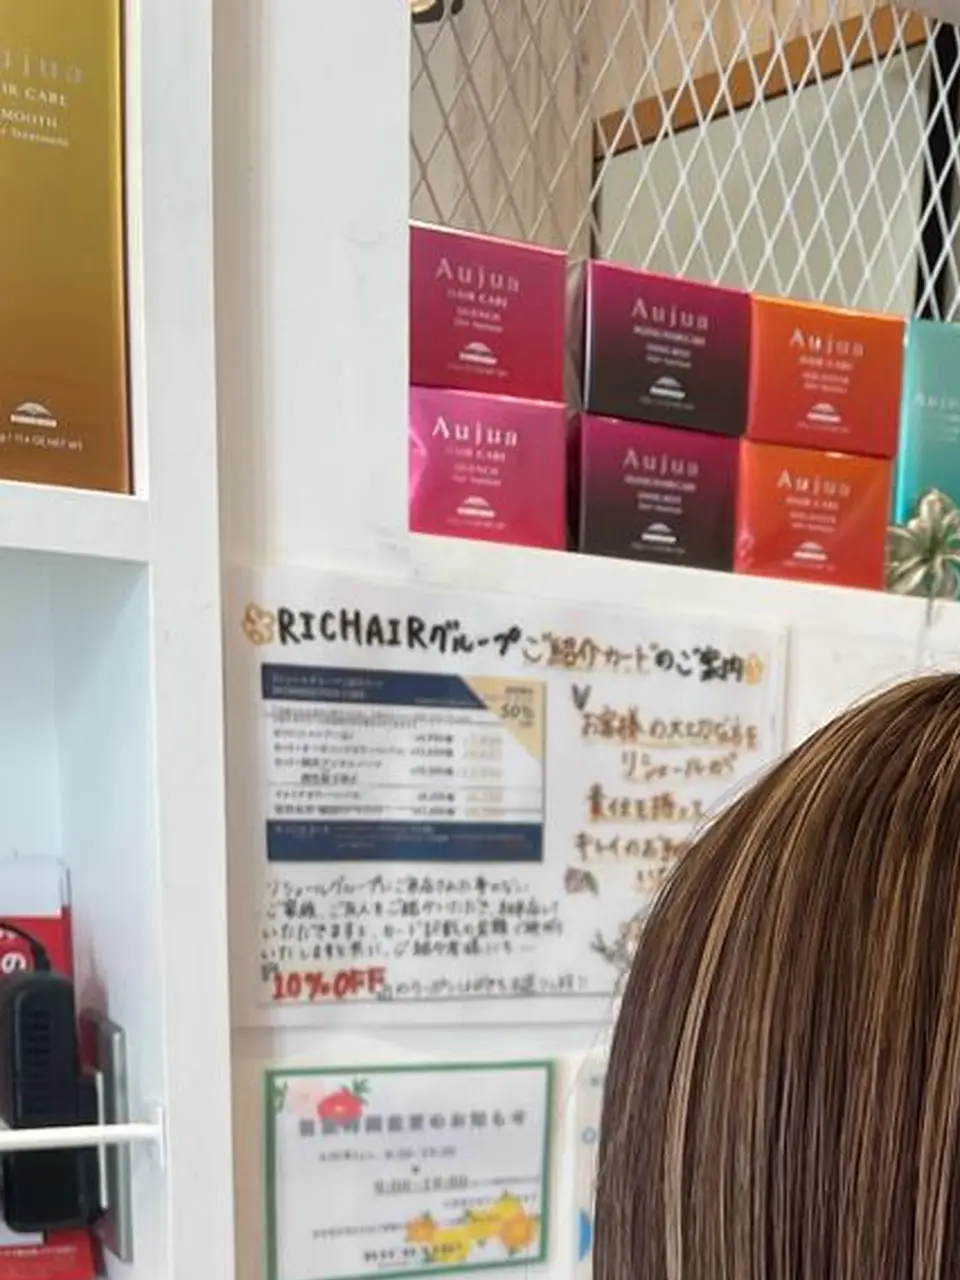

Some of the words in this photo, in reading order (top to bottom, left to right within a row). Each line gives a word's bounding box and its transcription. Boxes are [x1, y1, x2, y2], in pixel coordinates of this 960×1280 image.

[435, 257, 519, 292] Aujua
[631, 297, 709, 330] Aujua
[789, 328, 864, 357] Aujua
[432, 415, 518, 447] Aujua
[621, 446, 699, 477] Aujua
[776, 468, 851, 498] Aujua
